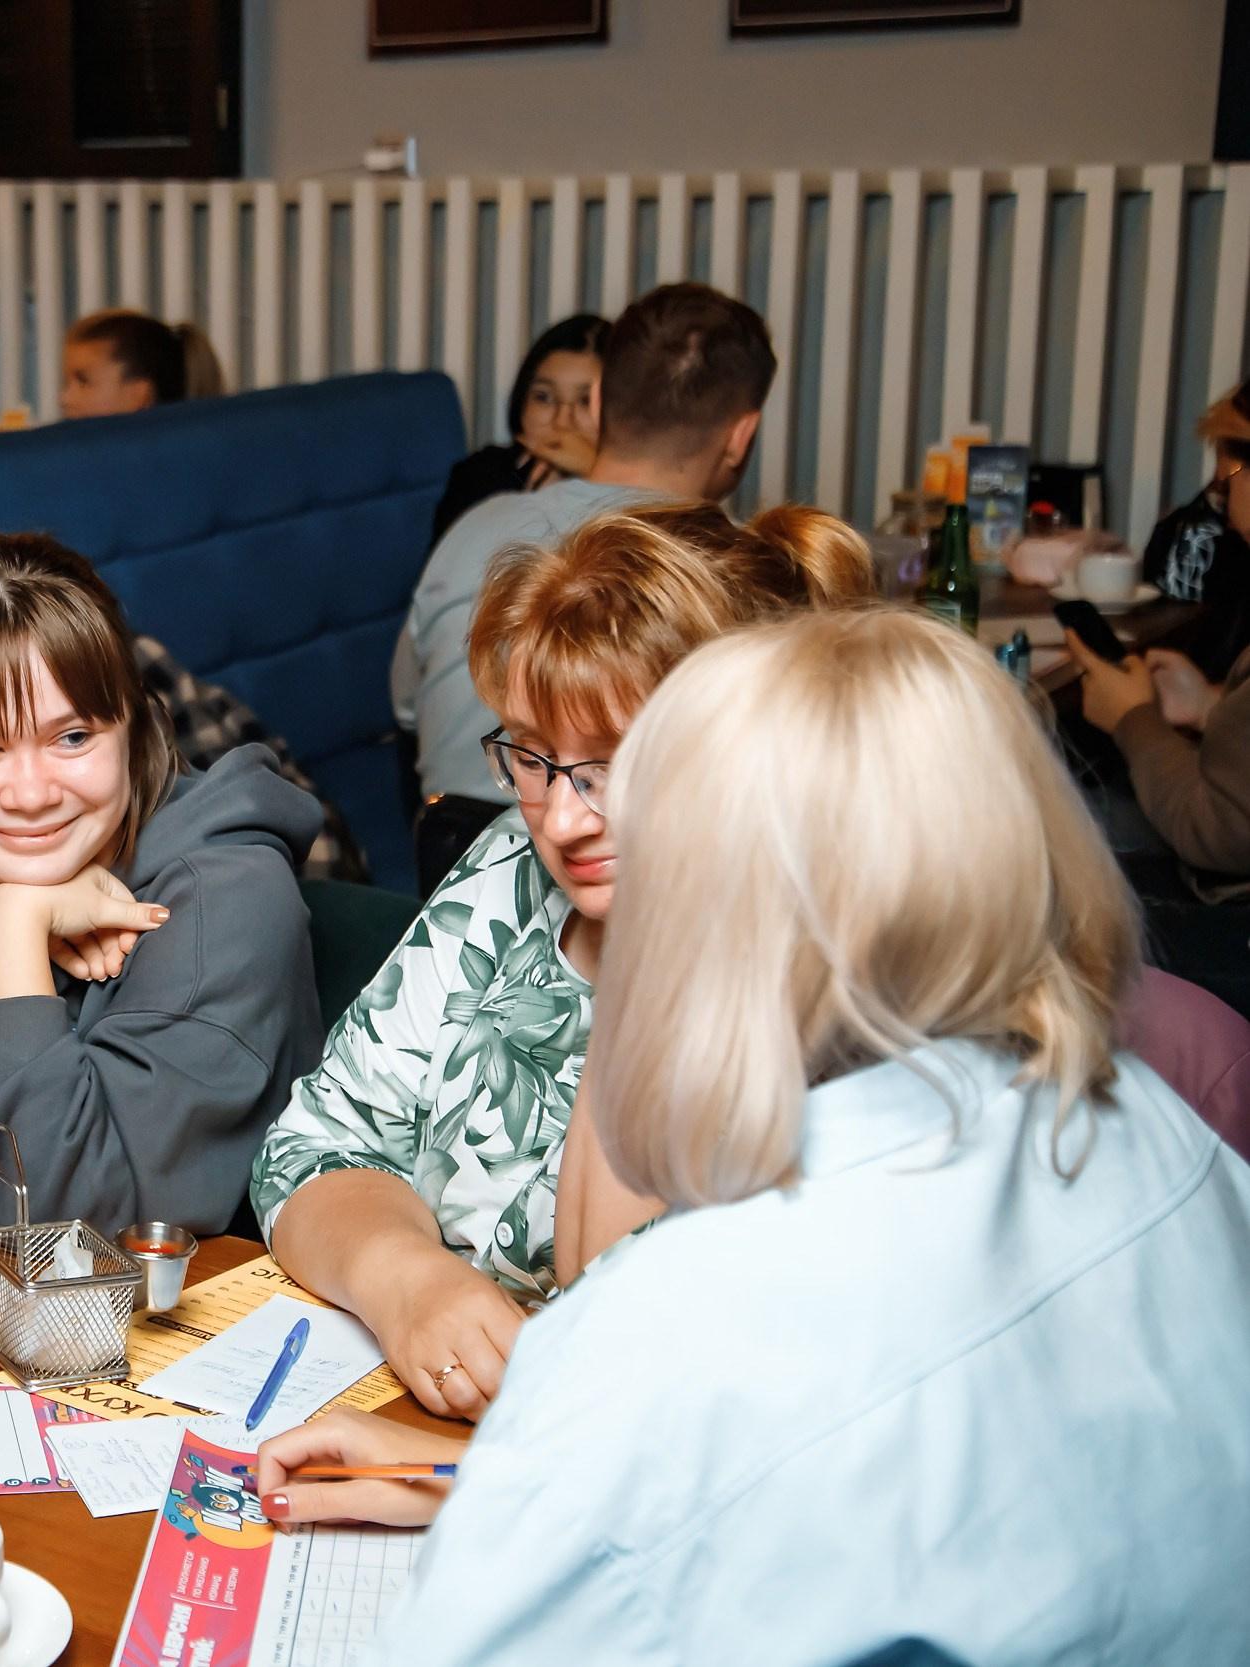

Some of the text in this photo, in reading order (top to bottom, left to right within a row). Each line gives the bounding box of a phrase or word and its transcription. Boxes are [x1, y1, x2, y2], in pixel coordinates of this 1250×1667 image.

[176, 1551, 195, 1595] ЗАПОЛНЯЕТСЯ
[192, 1557, 210, 1599] ПО ЖЕЛАНИЮ
[208, 1575, 223, 1602] КОМАНД
[224, 1589, 234, 1605] ДЛЯ
[162, 1602, 193, 1659] ВЕРСИЯ
